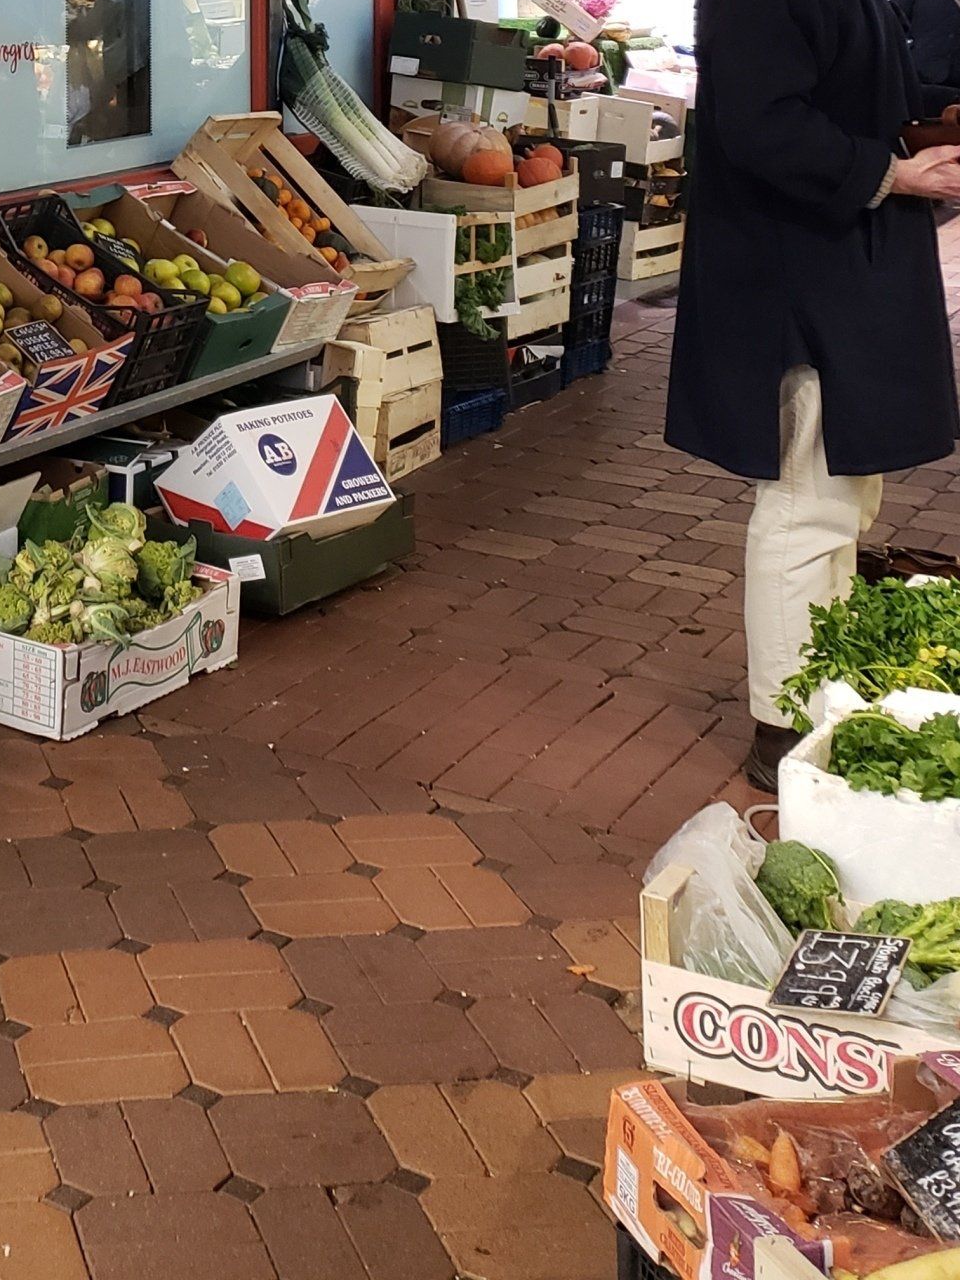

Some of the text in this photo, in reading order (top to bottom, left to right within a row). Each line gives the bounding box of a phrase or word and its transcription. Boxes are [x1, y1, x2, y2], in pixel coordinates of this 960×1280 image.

[236, 409, 314, 433] BAKING POTATOES
[341, 473, 381, 490] GROWERS
[334, 486, 389, 507] AND PACKERS
[133, 646, 186, 674] EASTWOOD
[674, 991, 903, 1098] CONS
[618, 1183, 636, 1216] 5KG
